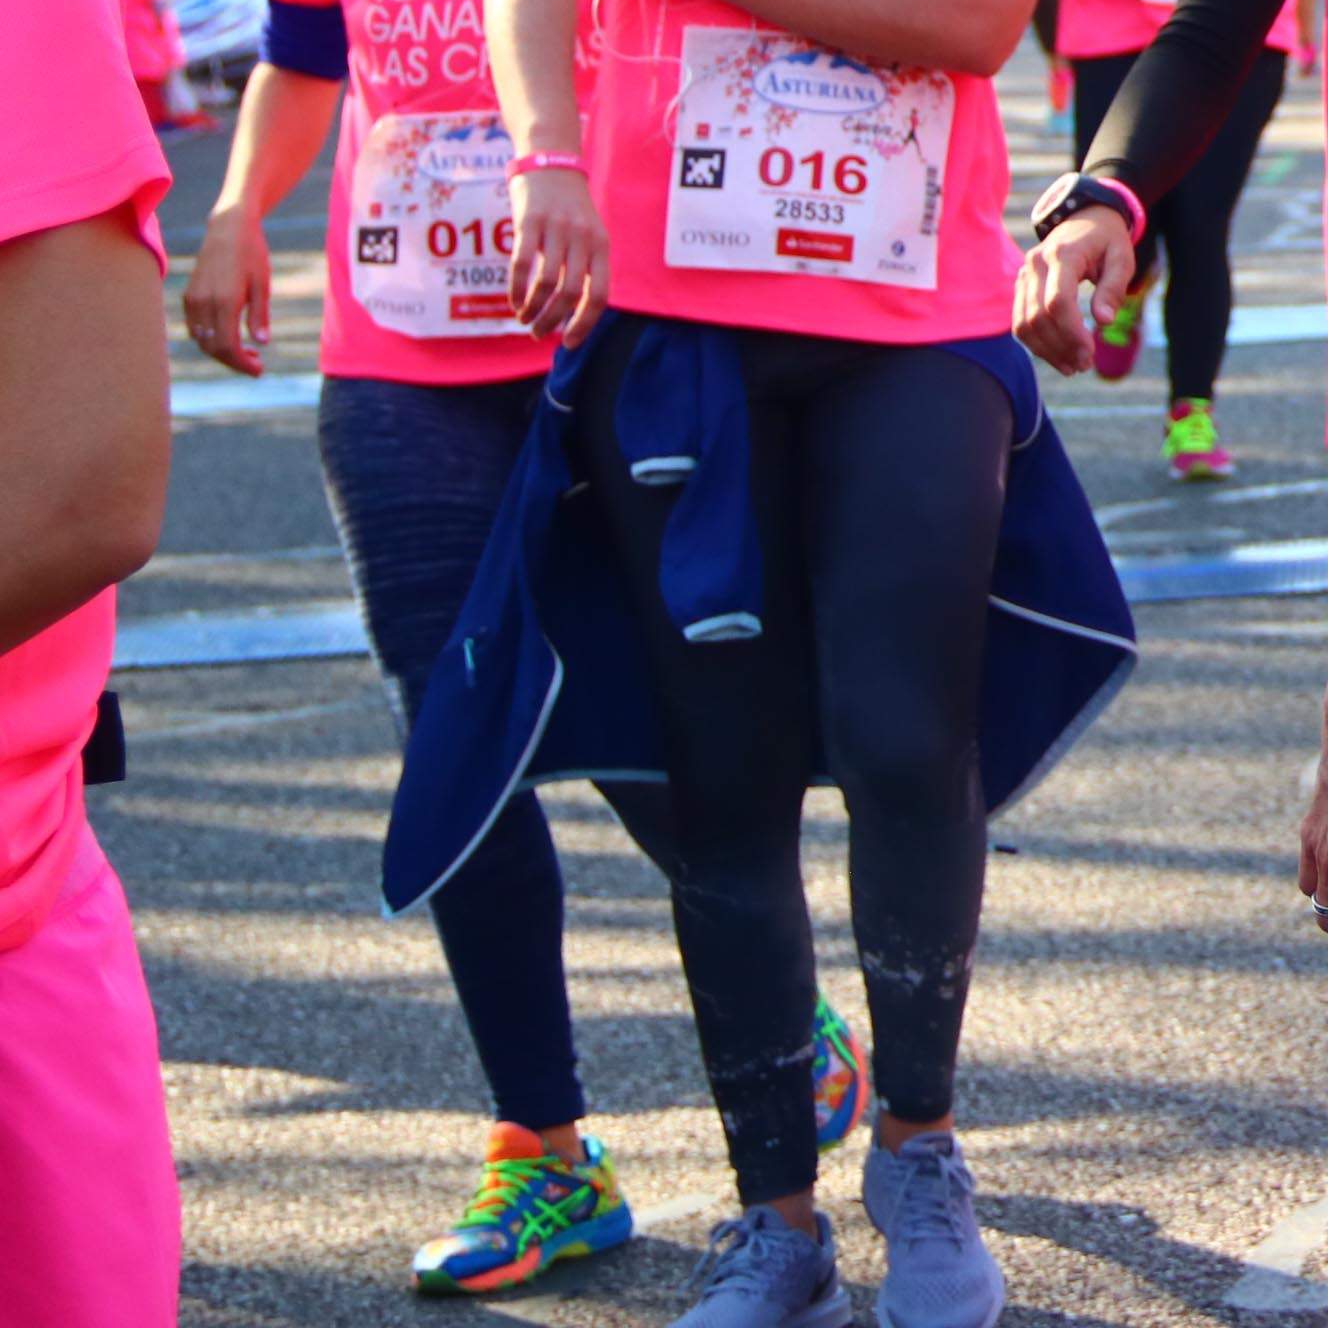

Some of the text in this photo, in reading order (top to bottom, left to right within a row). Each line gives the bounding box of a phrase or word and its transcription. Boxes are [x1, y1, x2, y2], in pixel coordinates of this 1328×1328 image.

[363, 0, 485, 44] GANA
[762, 72, 878, 102] ASTURIANA
[759, 146, 869, 195] 016
[773, 198, 846, 224] 28533
[681, 229, 750, 248] OYSHO
